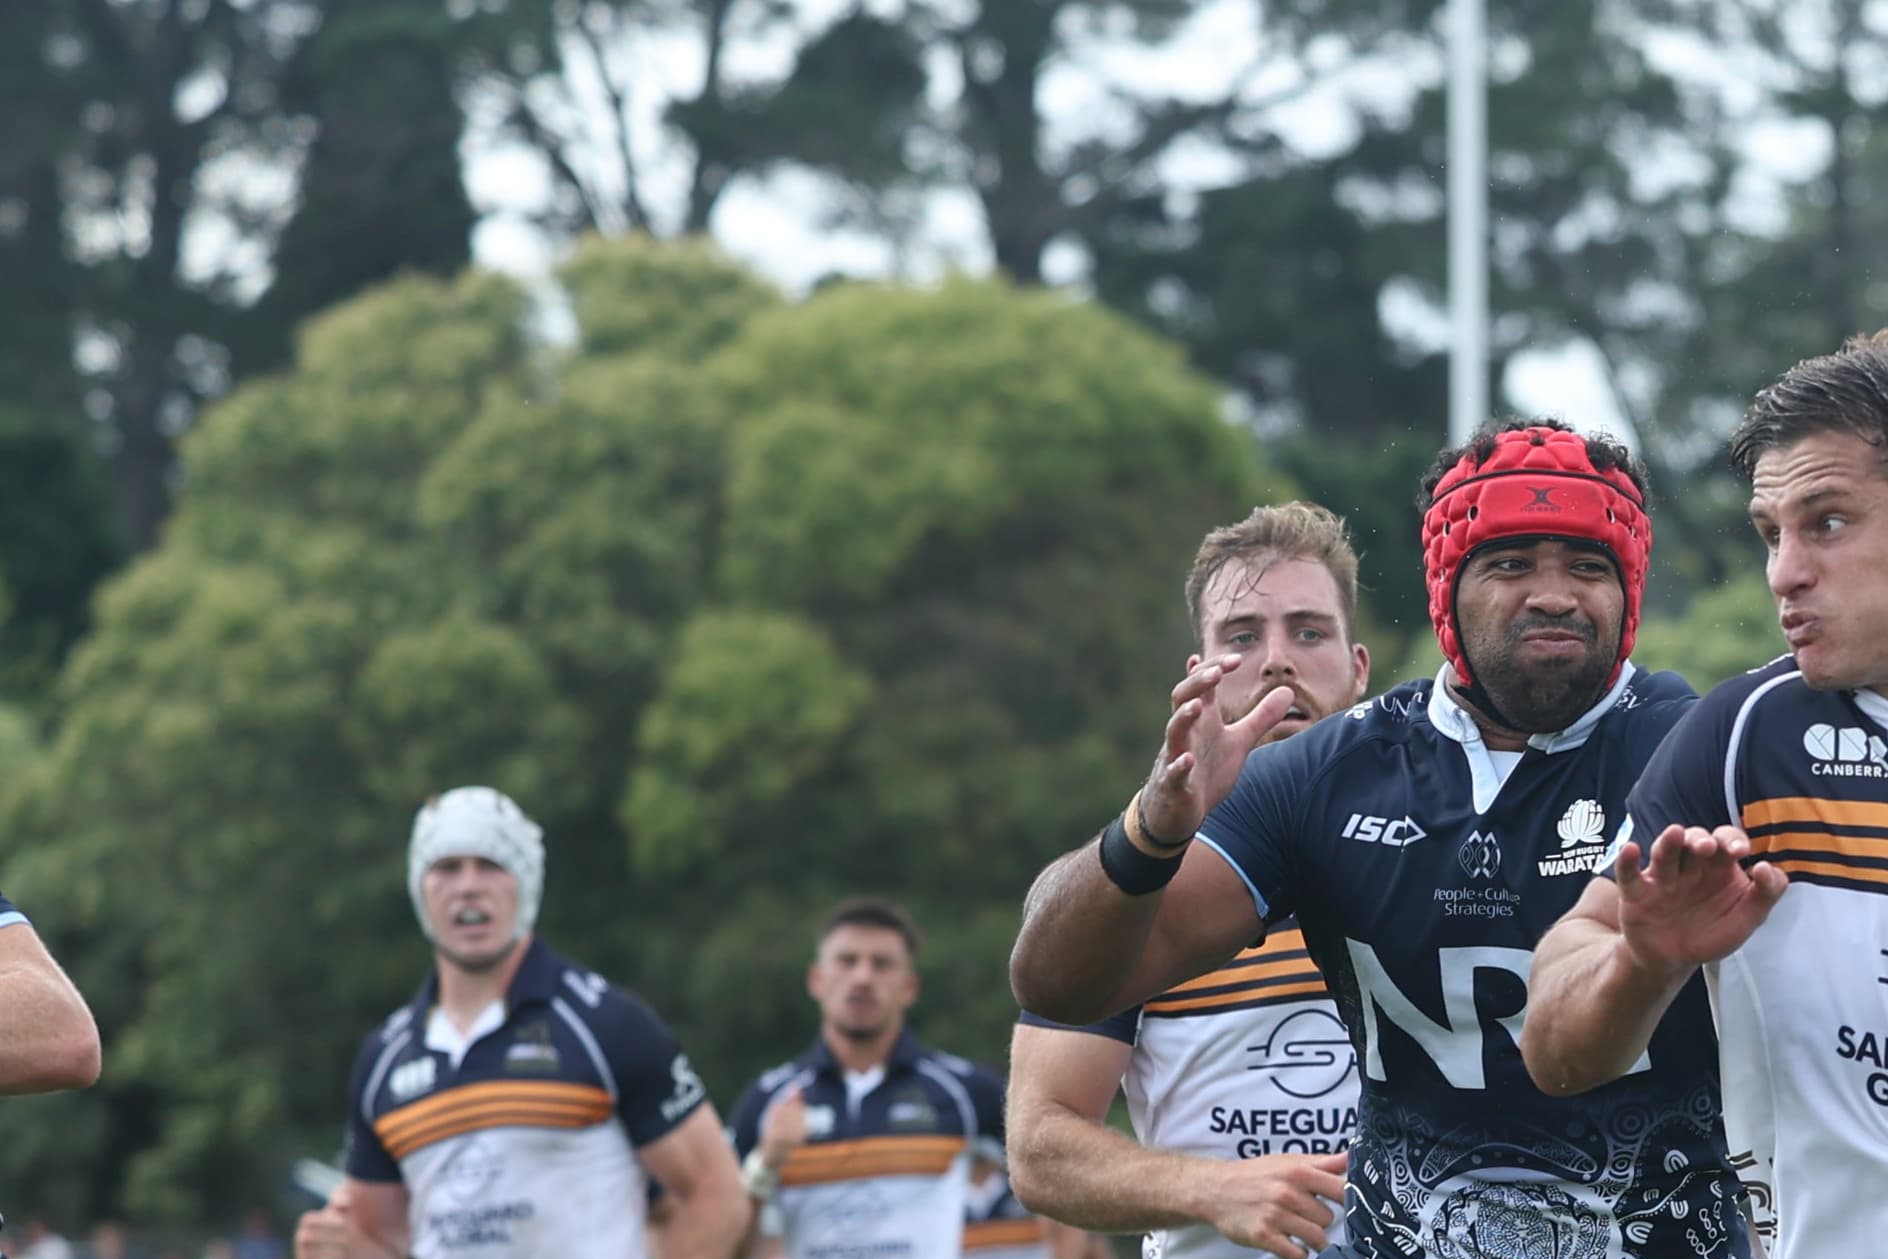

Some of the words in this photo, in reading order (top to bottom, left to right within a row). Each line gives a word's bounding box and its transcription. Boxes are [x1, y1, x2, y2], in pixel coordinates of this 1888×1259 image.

[1341, 813, 1406, 848] ISC
[1538, 853, 1606, 877] WARATA
[1444, 902, 1514, 919] Strategies
[1210, 1106, 1358, 1136] SAFEGUA
